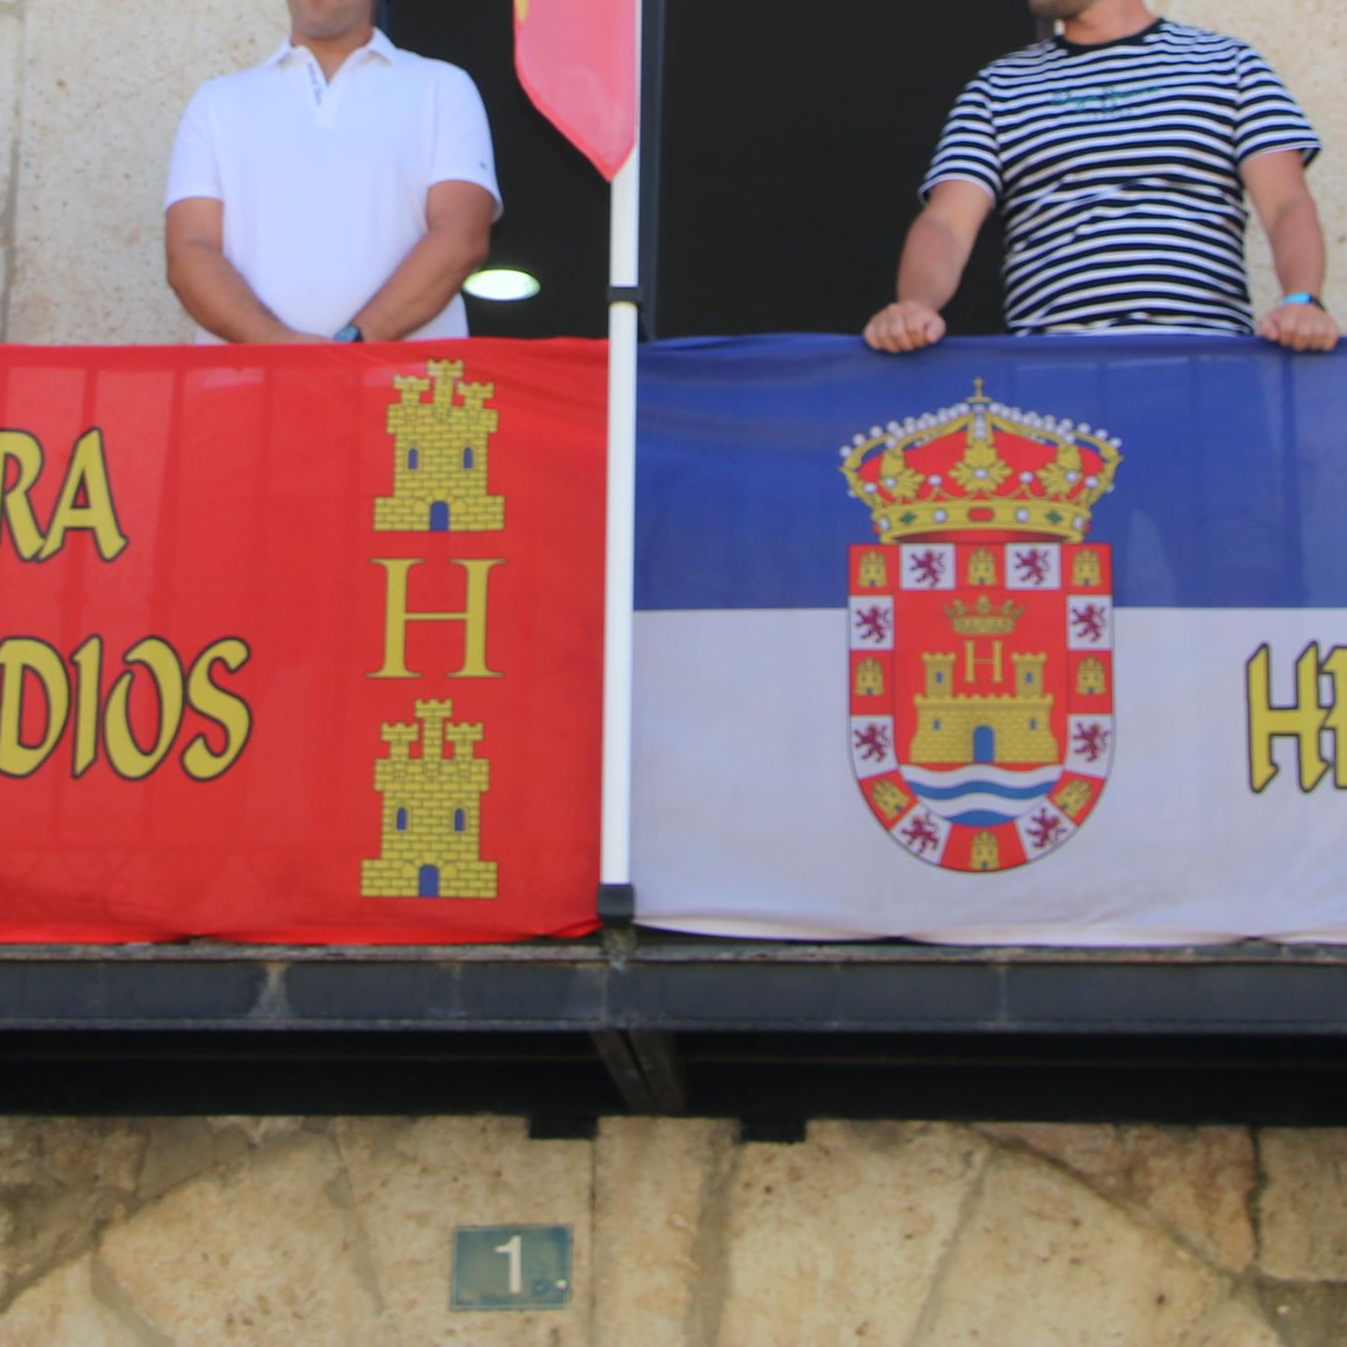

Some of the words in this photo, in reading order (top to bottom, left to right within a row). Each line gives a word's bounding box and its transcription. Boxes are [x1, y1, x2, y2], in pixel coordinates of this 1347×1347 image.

[365, 556, 508, 681] H
[964, 640, 1004, 683] H
[494, 1234, 522, 1294] 1
